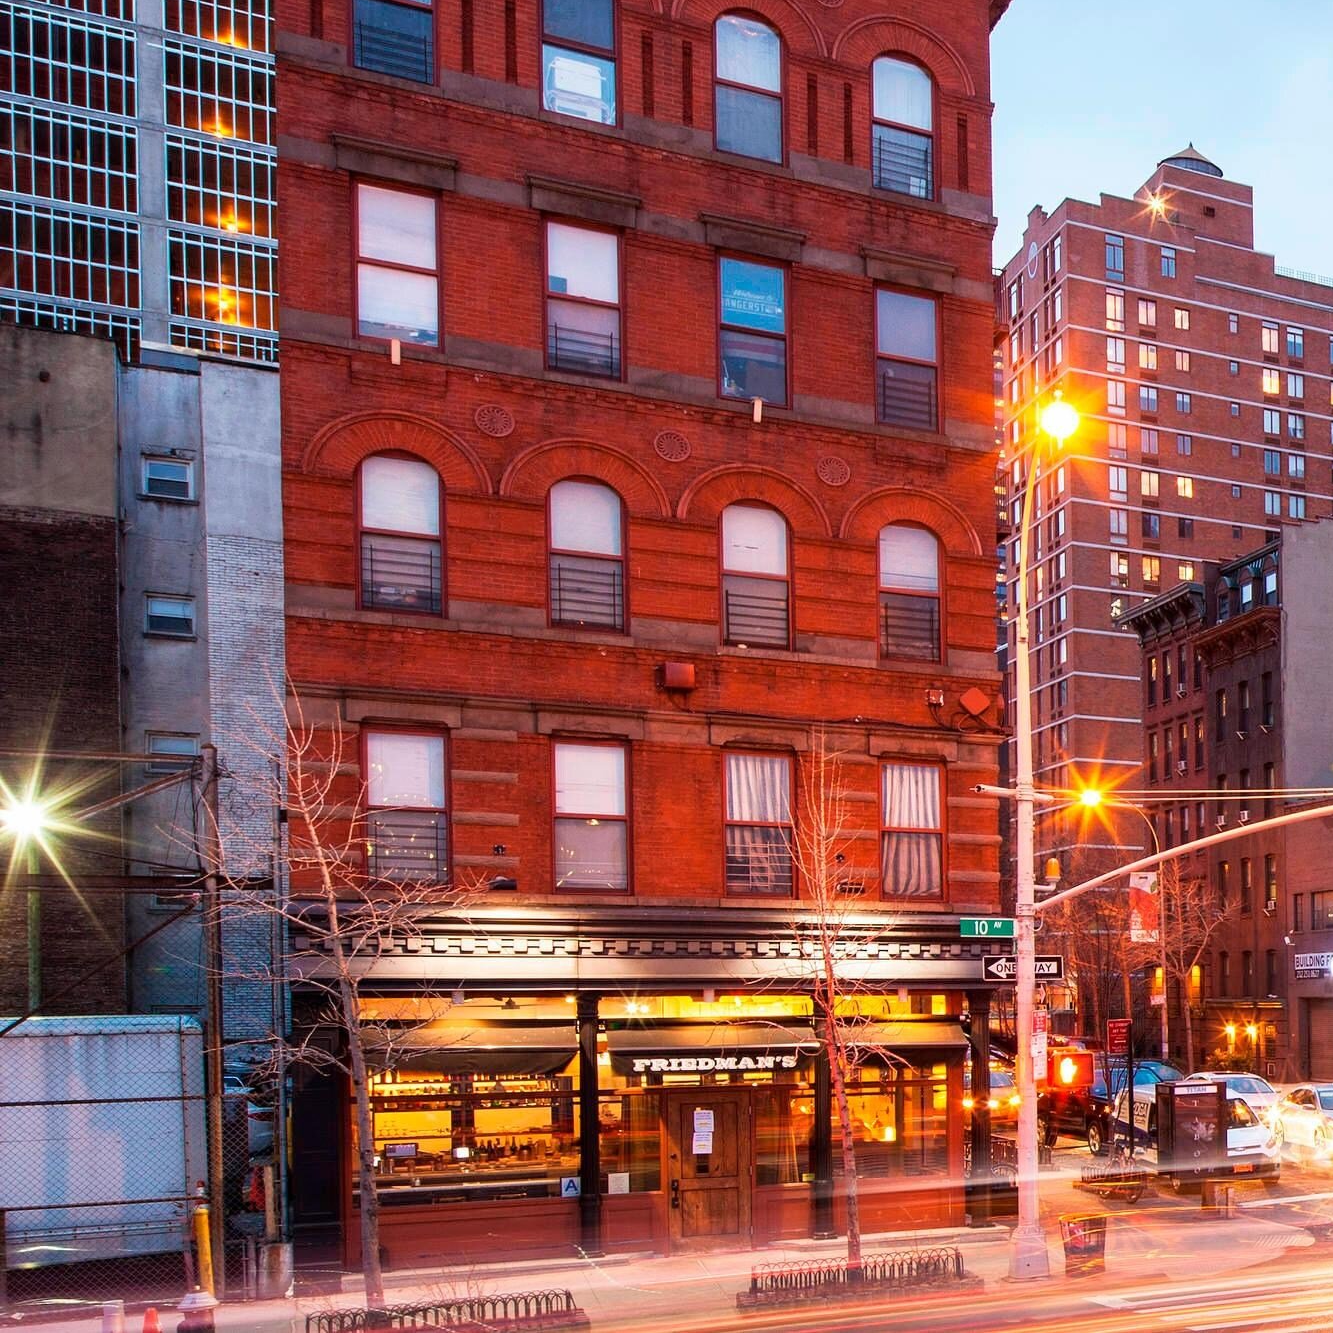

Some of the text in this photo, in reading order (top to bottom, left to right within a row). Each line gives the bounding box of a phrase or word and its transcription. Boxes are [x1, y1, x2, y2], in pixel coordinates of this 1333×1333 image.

[974, 920, 1003, 935] 10 AV
[996, 963, 1052, 973] ONE AY
[1296, 954, 1326, 968] BUILDING
[632, 1055, 798, 1072] FRIEDMAN'S
[564, 1179, 579, 1192] A
